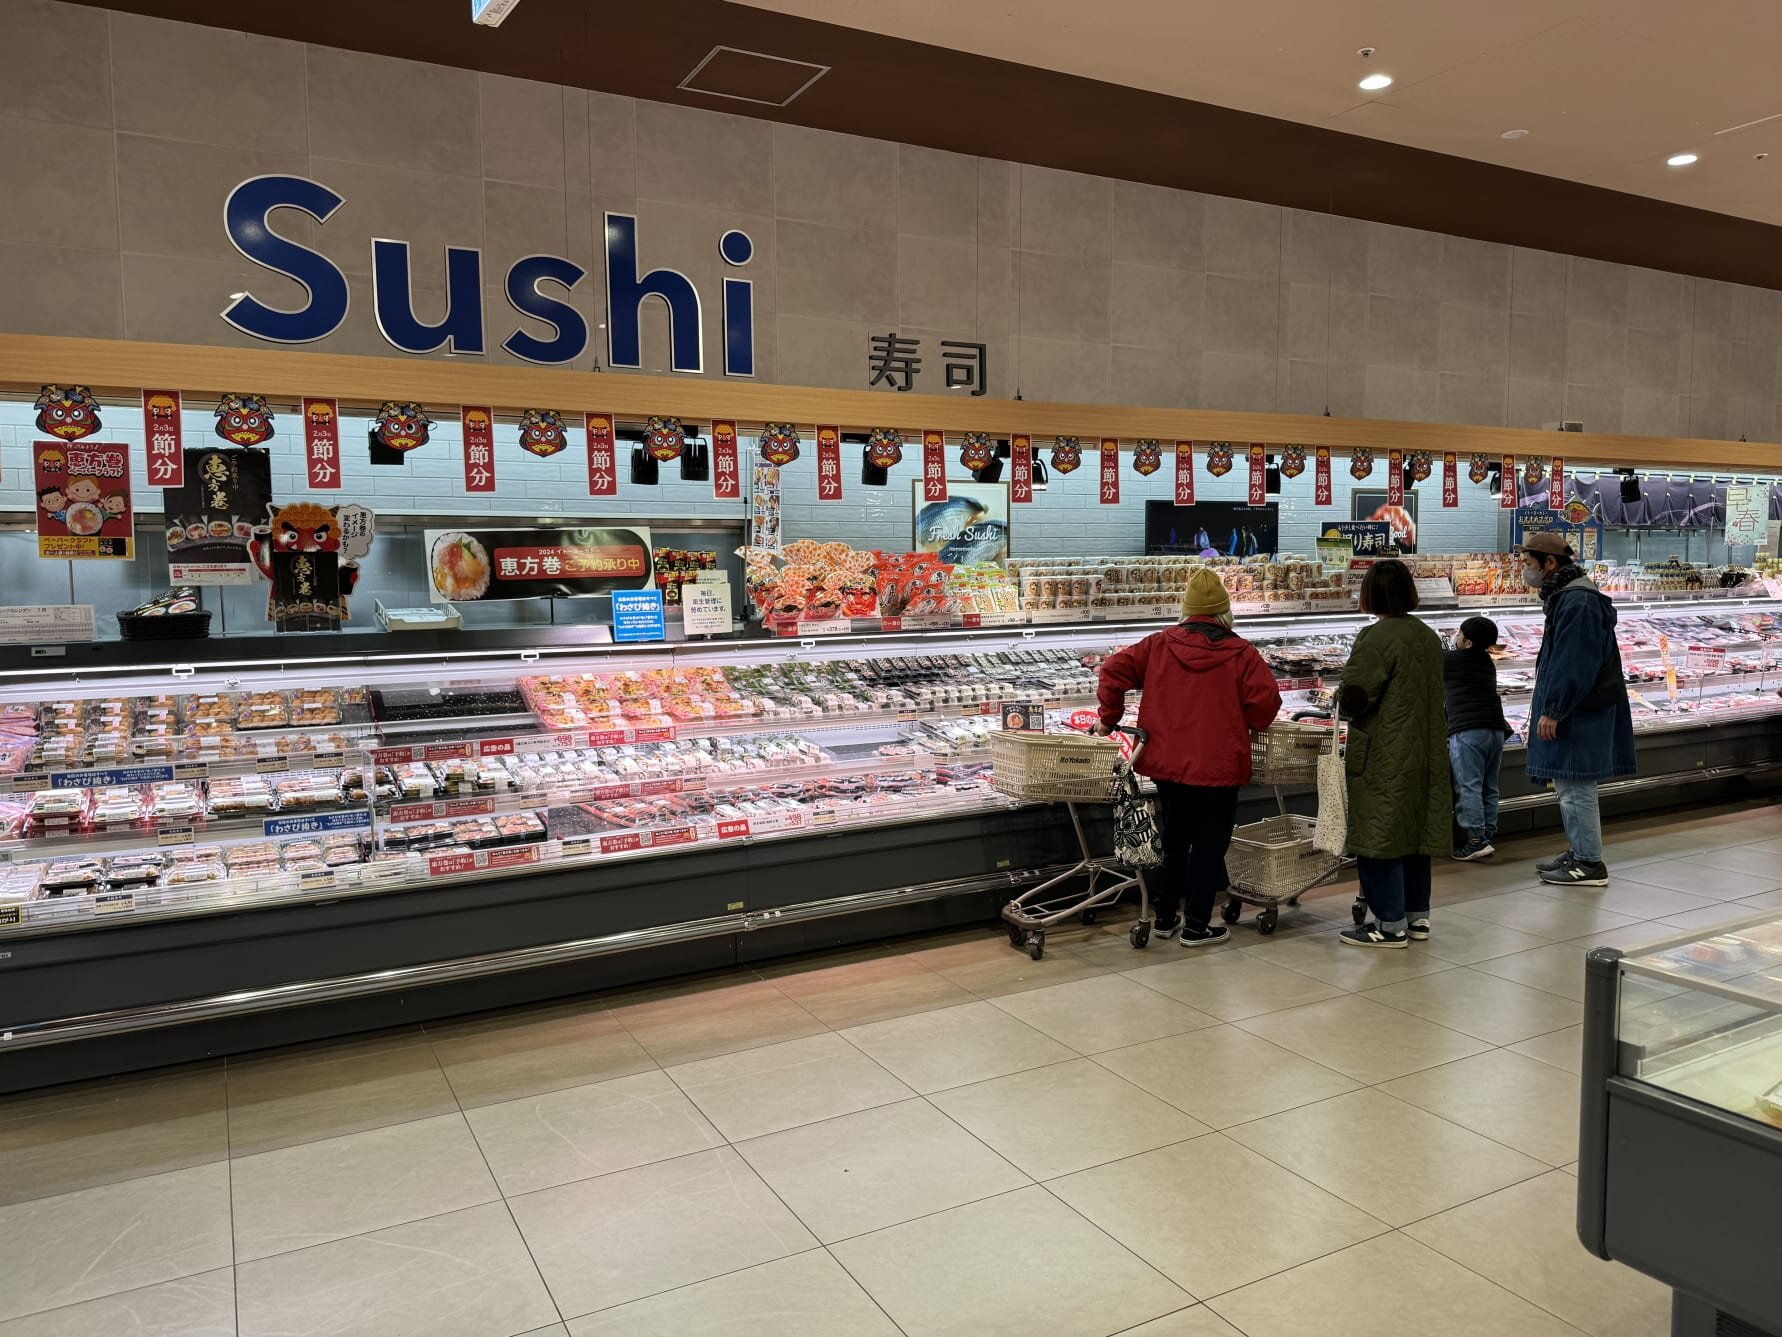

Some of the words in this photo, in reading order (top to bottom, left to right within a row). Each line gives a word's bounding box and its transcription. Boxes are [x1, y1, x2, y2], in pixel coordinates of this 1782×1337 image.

[221, 174, 754, 378] Sushi
[869, 332, 988, 396] 寿司
[153, 423, 174, 431] 2月3日
[67, 451, 124, 469] 恵方巻
[152, 433, 178, 480] 節分
[311, 438, 336, 484] 節分
[468, 444, 491, 486] 節分
[591, 450, 613, 490] 節分
[204, 455, 230, 510] 恵方巻
[717, 455, 736, 493] 節分
[820, 459, 838, 495] 節分
[927, 462, 943, 497] 節分
[1014, 465, 1029, 498] 節分
[1103, 468, 1116, 500] 節分
[1178, 469, 1191, 501] 節分
[1251, 471, 1263, 501] 節分
[1317, 472, 1329, 502] 節分
[1390, 475, 1401, 502] 節分
[1445, 477, 1456, 503] 節分
[1503, 478, 1514, 504] 節分
[1551, 480, 1562, 506] 節分
[928, 525, 961, 542] Fresh
[964, 524, 998, 541] Sushi
[1343, 532, 1386, 552] り寿司
[499, 556, 562, 576] 恵方巻
[565, 558, 640, 572] ご予約承り中
[483, 743, 512, 753] 広告の品
[57, 775, 117, 787] 「わさび抜き」
[270, 821, 323, 833] 「わさび抜き」
[721, 823, 747, 834] 広告の品
[1568, 867, 1585, 879] N
[1367, 929, 1385, 942] N
